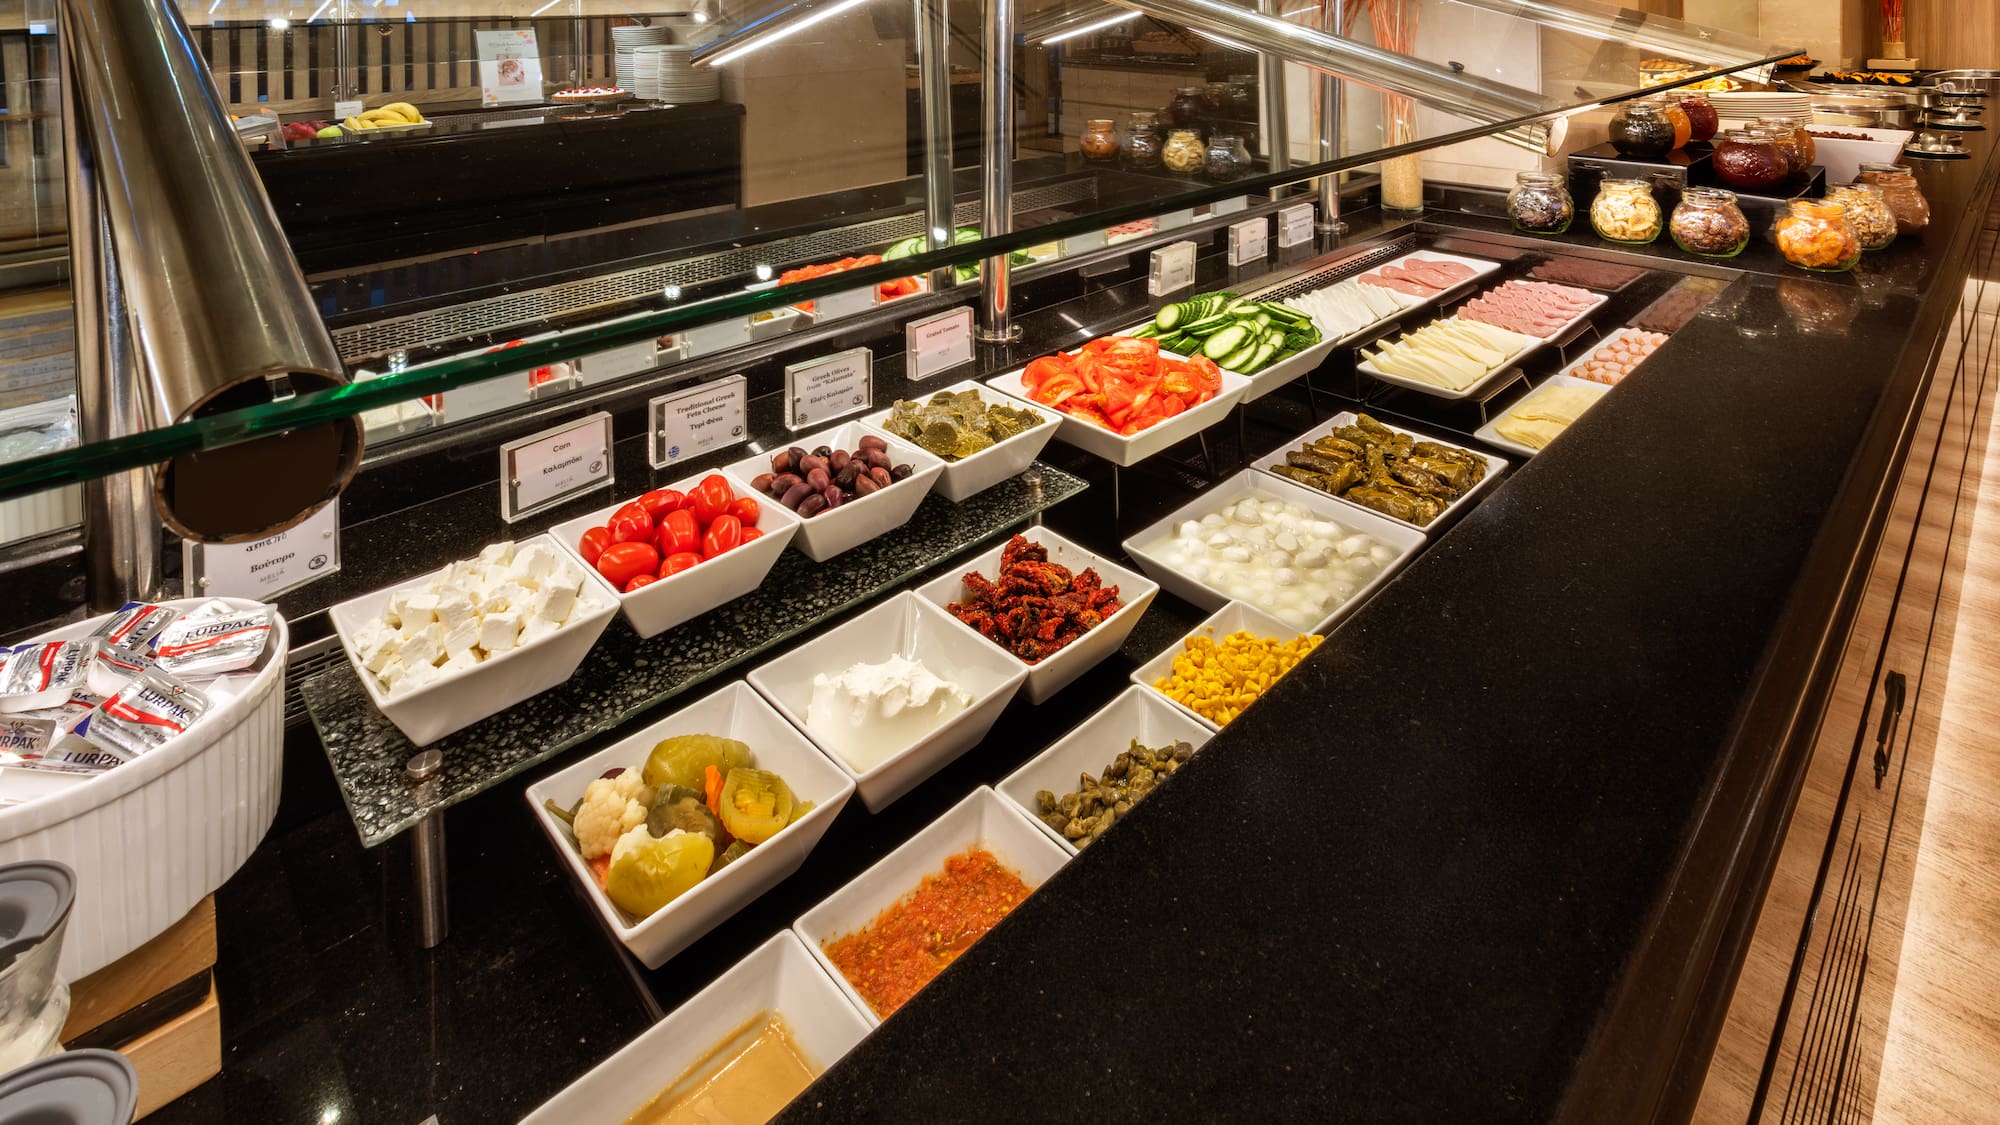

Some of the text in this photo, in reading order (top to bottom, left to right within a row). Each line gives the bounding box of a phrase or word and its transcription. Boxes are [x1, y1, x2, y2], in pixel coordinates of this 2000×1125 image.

[676, 391, 736, 415] Traditional Greek
[686, 402, 727, 420] Feta Cheese
[552, 441, 571, 453] Corn
[186, 619, 255, 639] LURPAK
[55, 648, 80, 684] LURPAK
[138, 687, 190, 719] LURPAK
